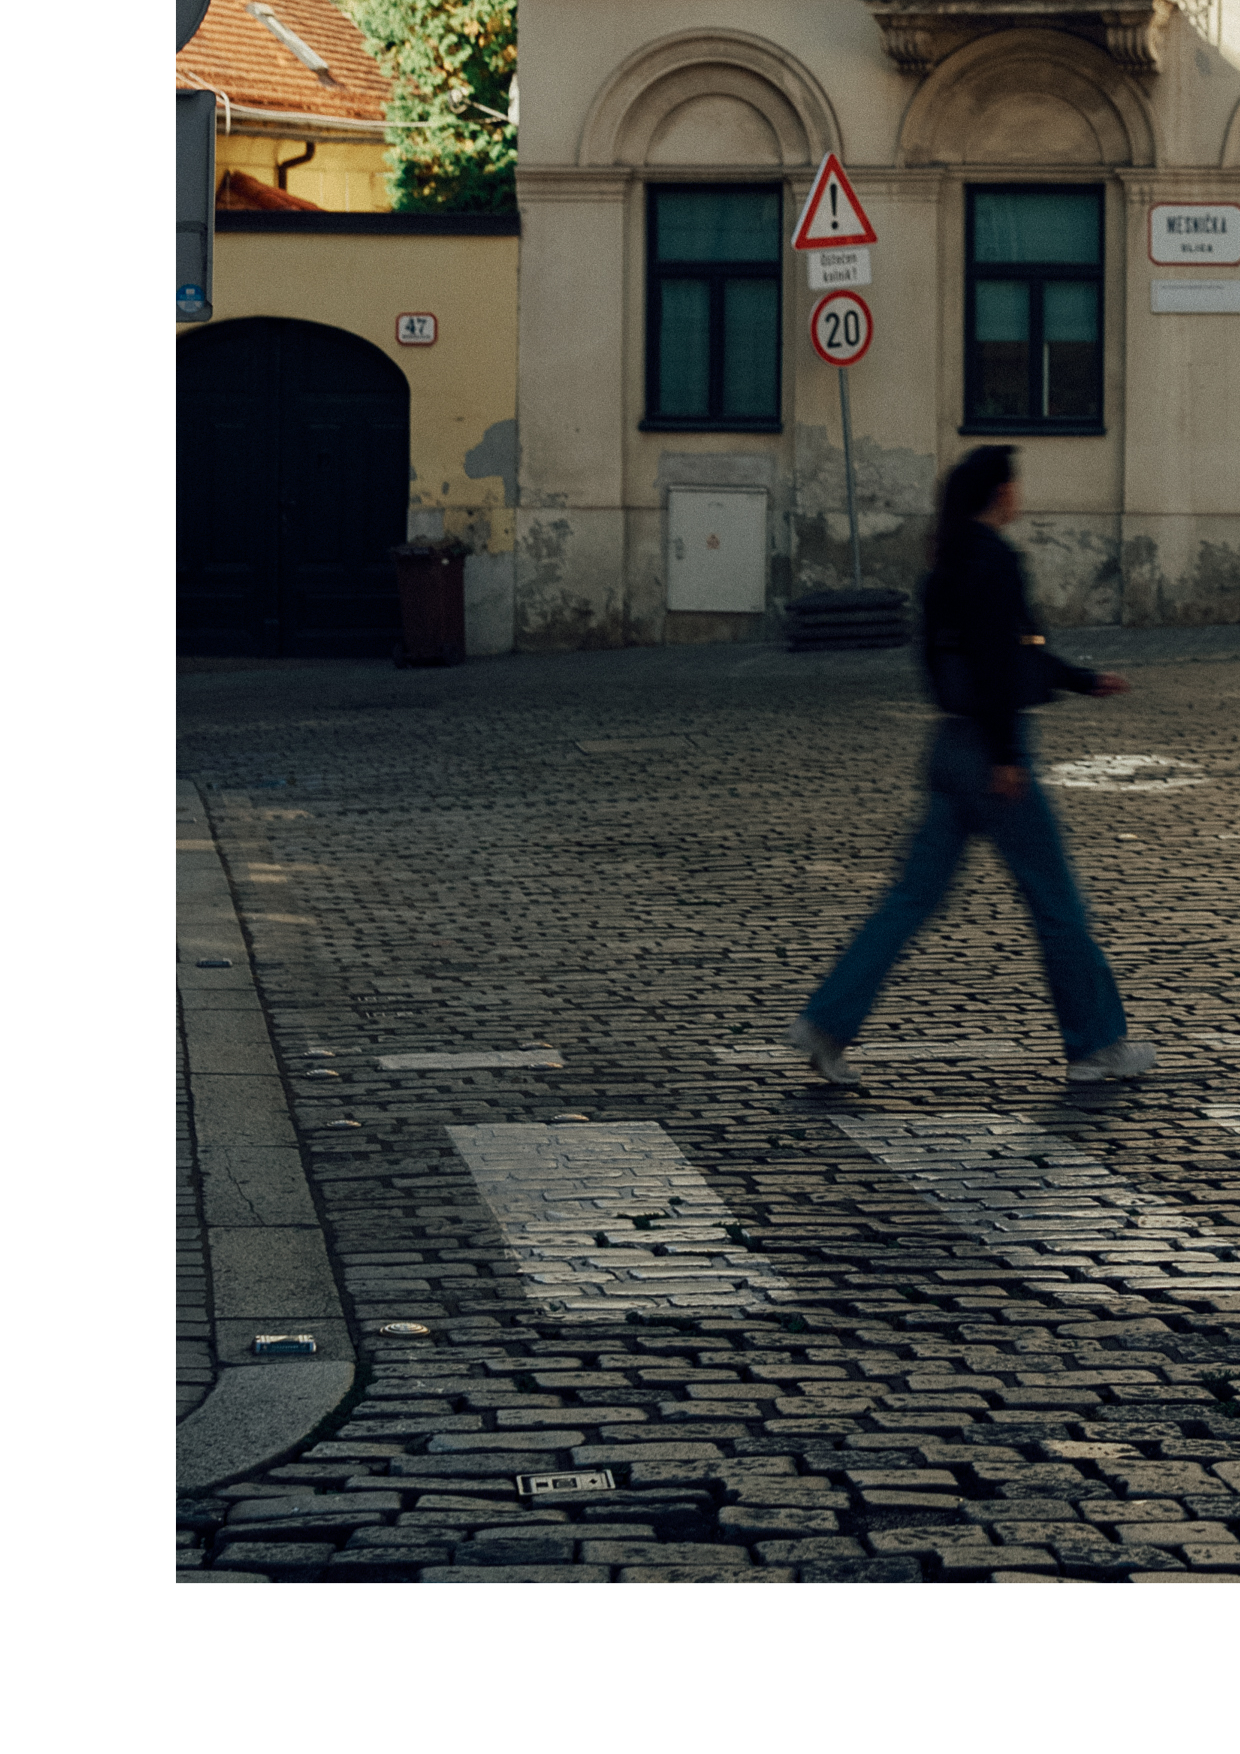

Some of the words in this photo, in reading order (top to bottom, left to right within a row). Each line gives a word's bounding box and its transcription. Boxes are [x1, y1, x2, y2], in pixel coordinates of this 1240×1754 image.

[1167, 214, 1226, 234] MESNIČKA
[405, 318, 427, 334] 47
[825, 310, 860, 348] 20
